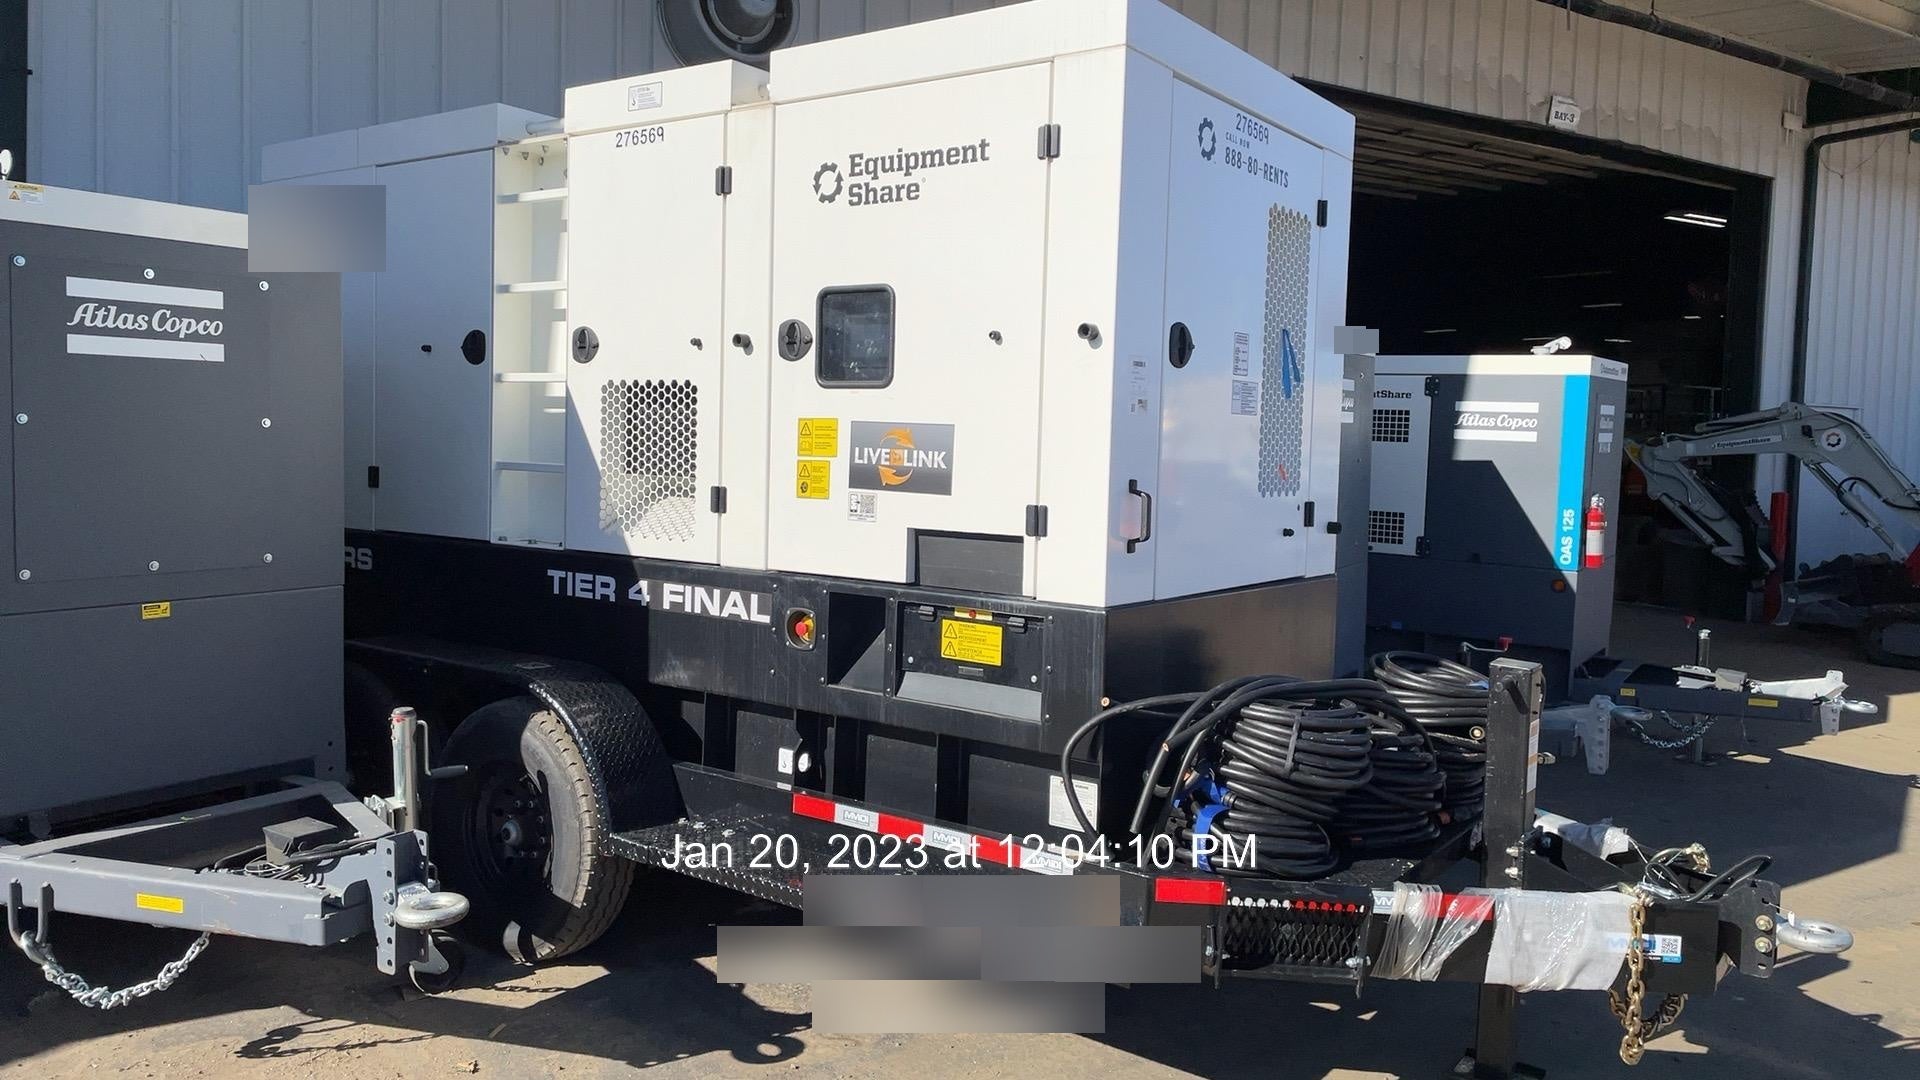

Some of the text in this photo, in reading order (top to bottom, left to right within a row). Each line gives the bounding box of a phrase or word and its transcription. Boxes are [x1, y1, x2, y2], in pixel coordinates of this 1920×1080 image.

[1236, 112, 1269, 145] 276569
[1553, 110, 1575, 123] BAY-3
[615, 126, 665, 148] 276569
[1225, 132, 1238, 145] CALL
[848, 138, 990, 180] Equipment
[1225, 146, 1289, 188] 888-80-RENTS
[848, 182, 920, 206] Share
[66, 302, 224, 339] Atlas Copco
[1373, 390, 1412, 399] tShare
[1453, 412, 1538, 430] Atlas Copco
[854, 446, 947, 470] LIVE LINK
[1560, 508, 1575, 566] QAS 125
[547, 568, 771, 624] TIER 4 FINAL
